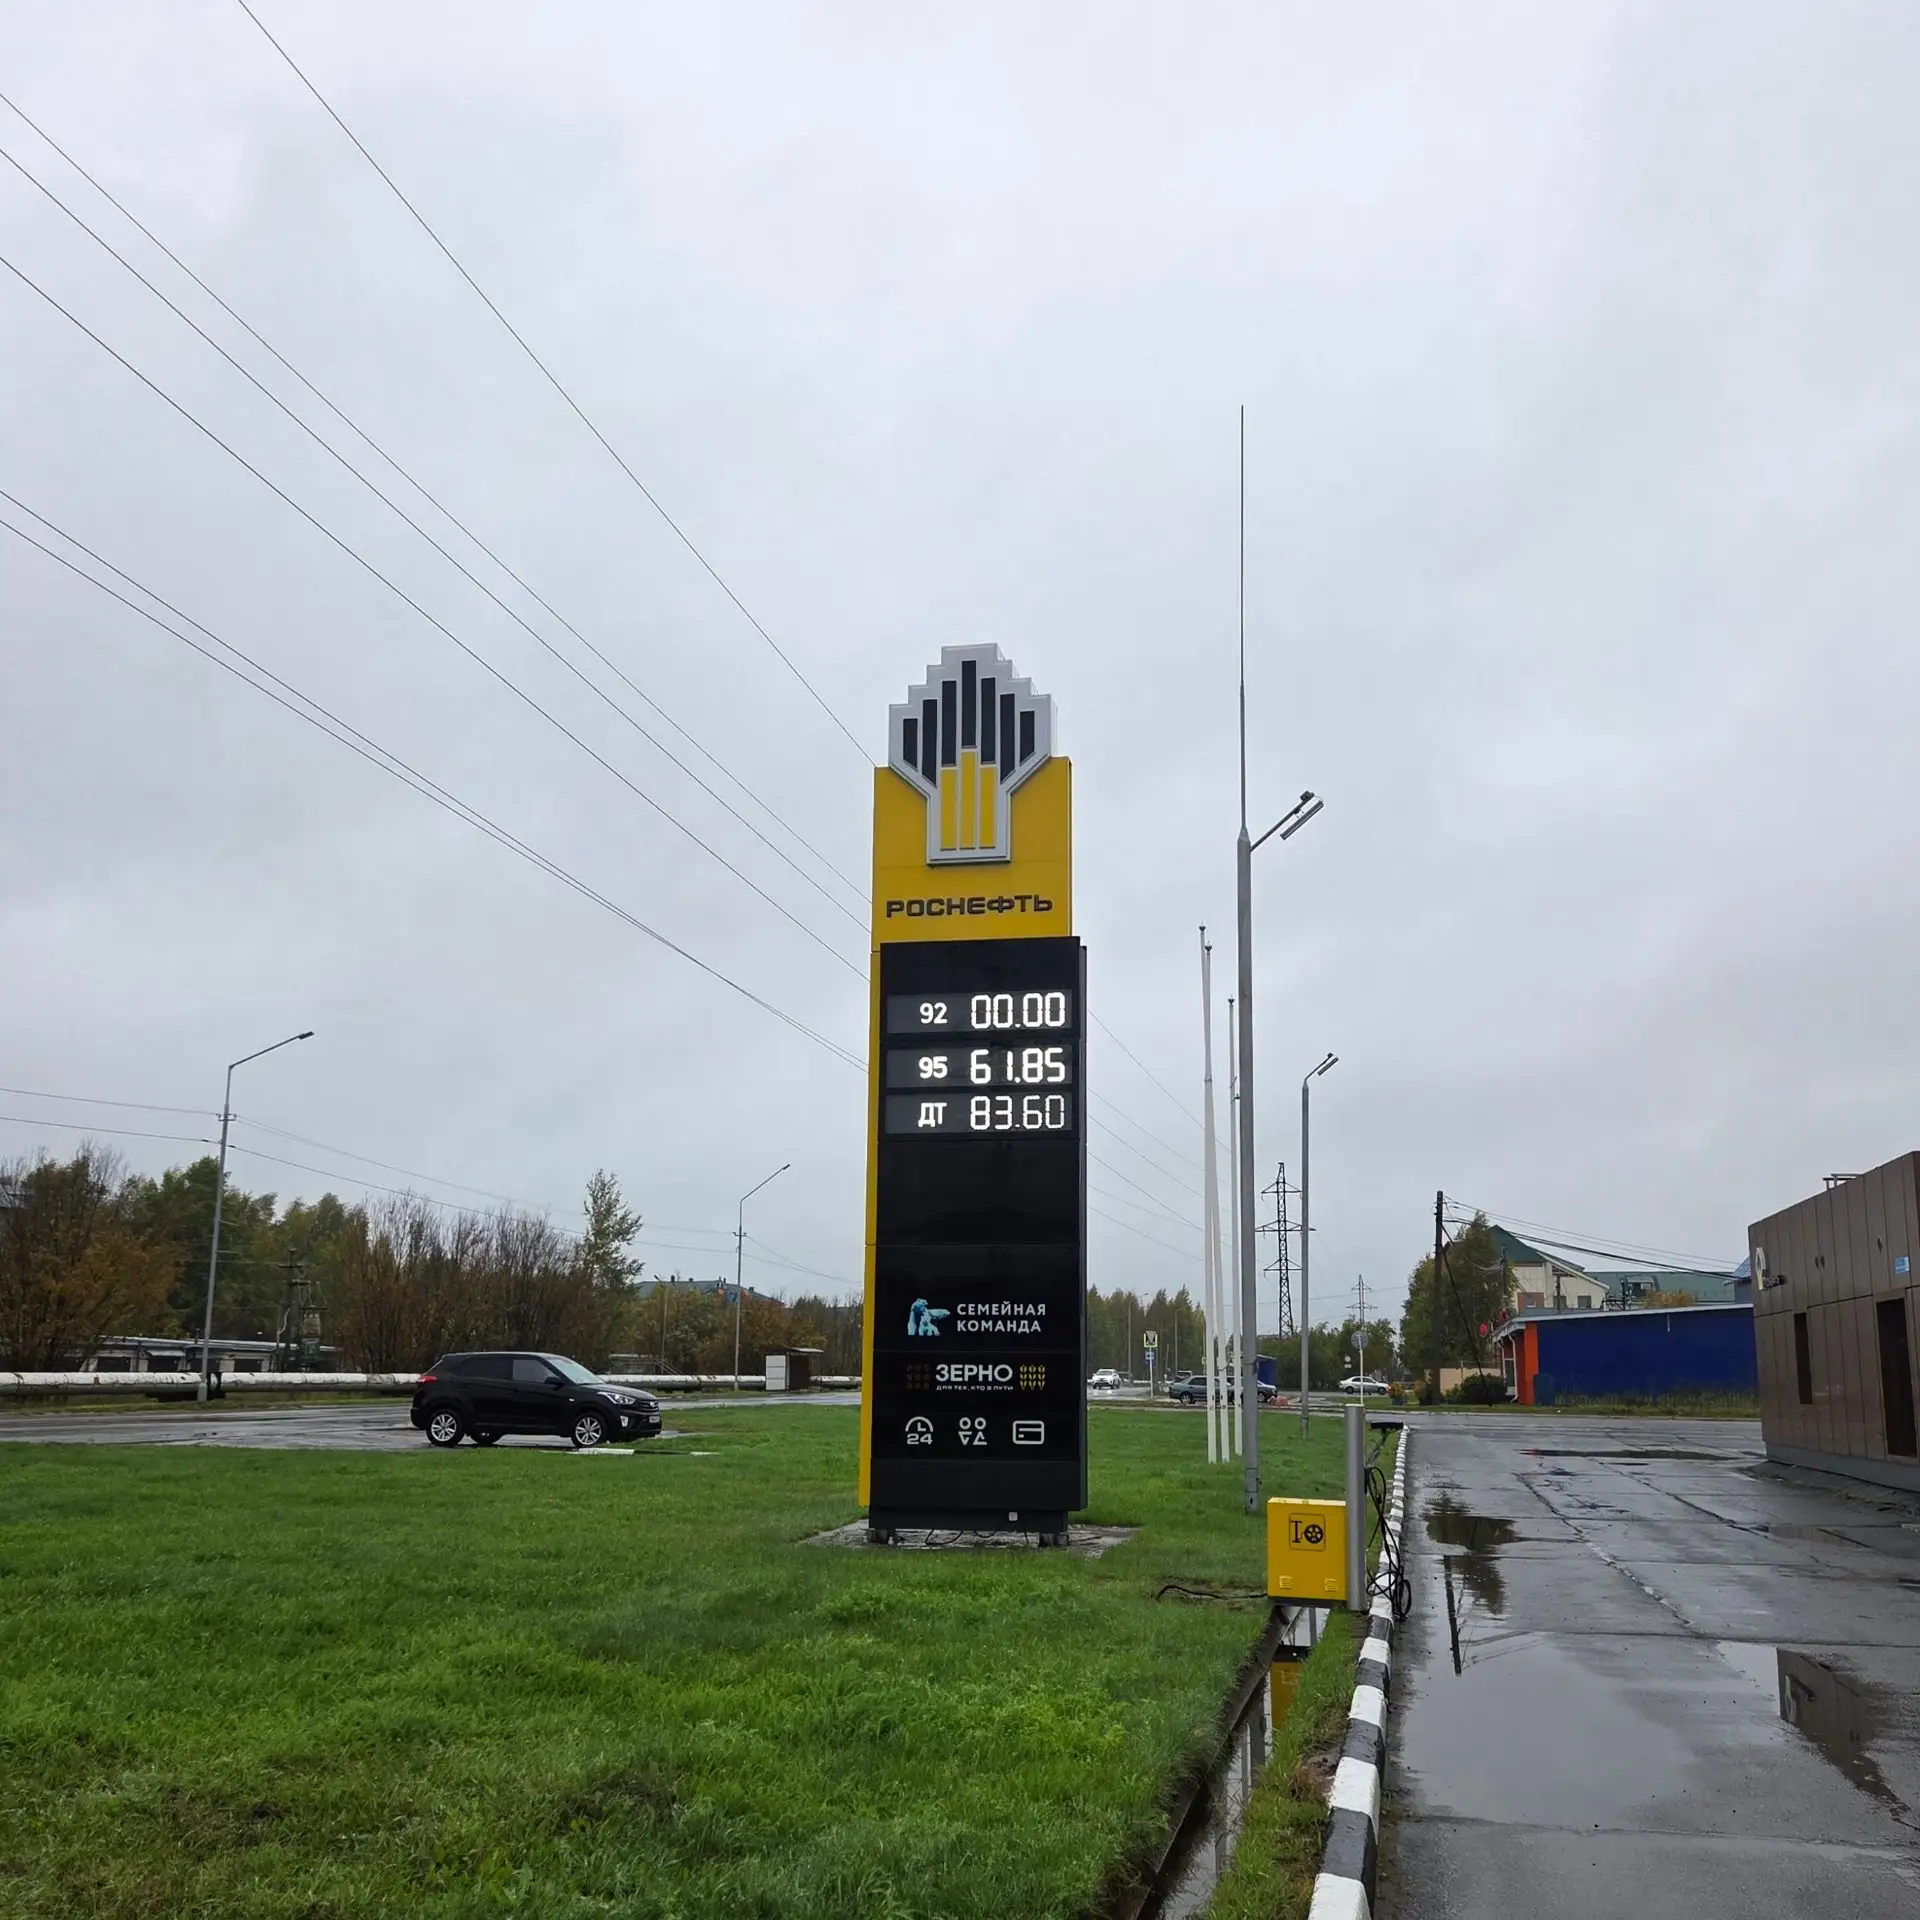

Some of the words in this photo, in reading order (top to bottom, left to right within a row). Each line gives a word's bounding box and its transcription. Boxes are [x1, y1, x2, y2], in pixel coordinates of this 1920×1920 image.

[886, 894, 1053, 918] РОСНЕФТЬ
[919, 1003, 948, 1024] 92
[970, 992, 1066, 1029] 00.00
[918, 1056, 948, 1079] 95
[970, 1047, 1066, 1085] 61.85
[918, 1102, 948, 1128] ДТ
[970, 1094, 1065, 1131] 83.60
[956, 1301, 1046, 1316] СЕМЕЙНАЯ
[957, 1319, 1041, 1334] КОМАНДА
[935, 1364, 1014, 1382] ЗЕРНО
[906, 1433, 933, 1445] 24
